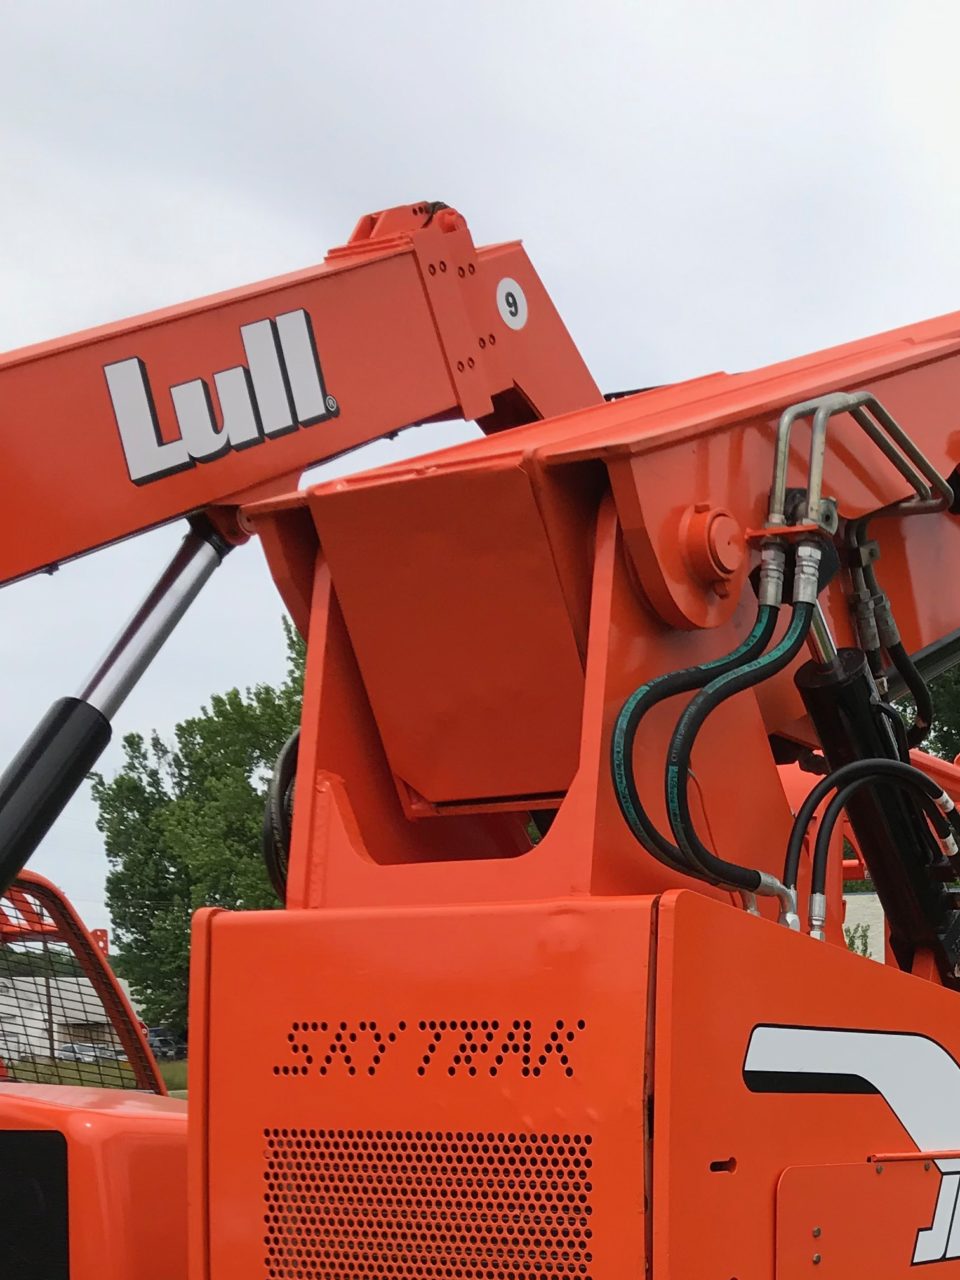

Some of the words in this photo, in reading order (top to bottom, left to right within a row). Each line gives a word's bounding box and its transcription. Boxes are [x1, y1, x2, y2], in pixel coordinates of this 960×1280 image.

[505, 291, 519, 317] 9
[104, 307, 330, 486] Lull
[272, 1019, 586, 1077] SKYTRAK
